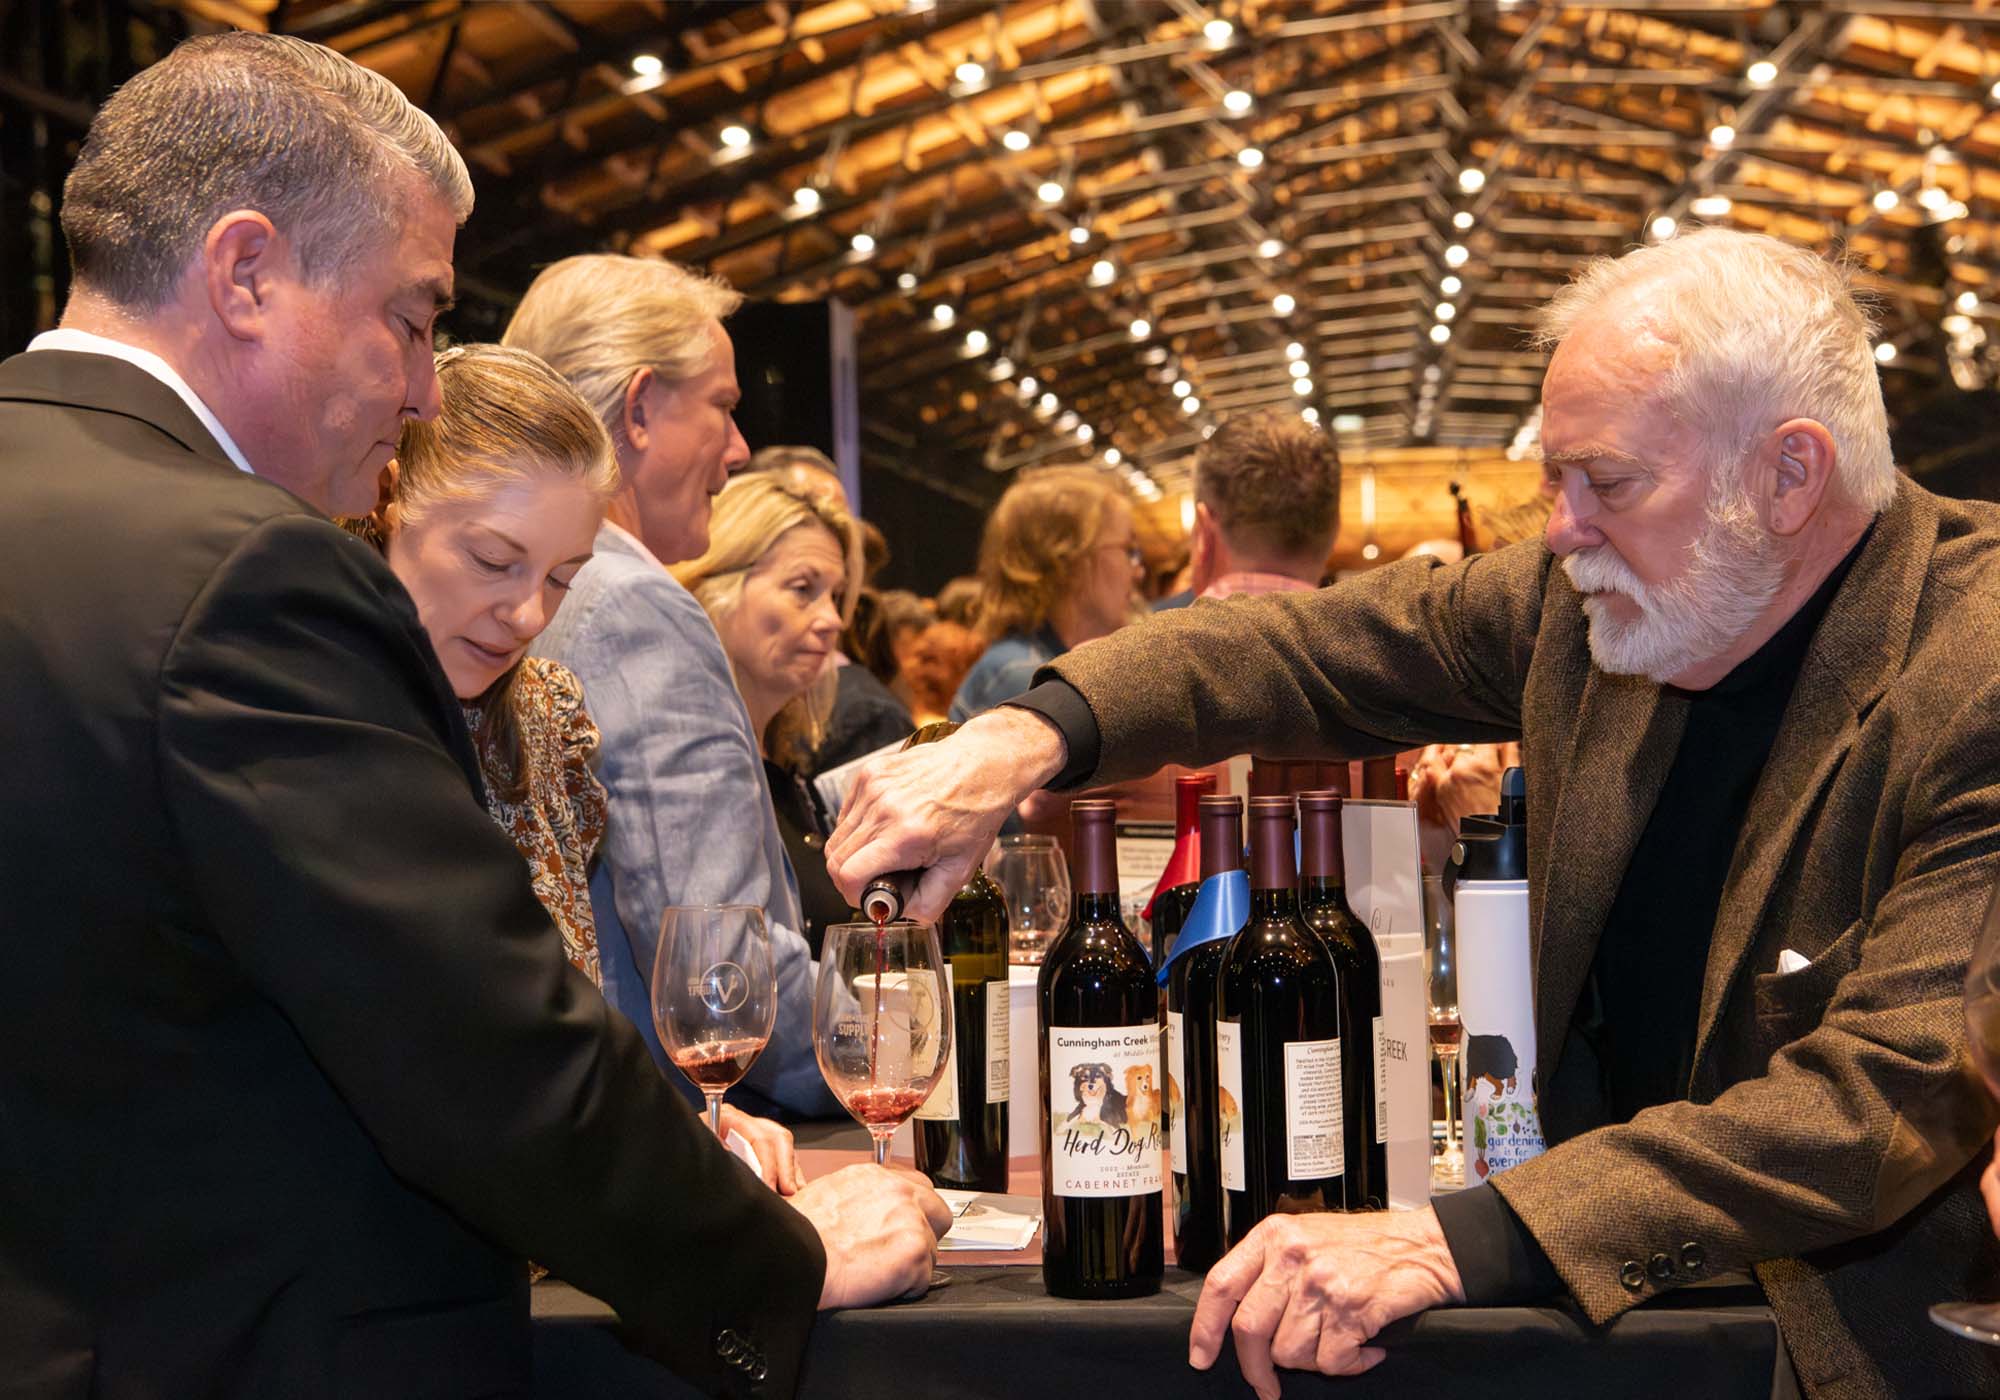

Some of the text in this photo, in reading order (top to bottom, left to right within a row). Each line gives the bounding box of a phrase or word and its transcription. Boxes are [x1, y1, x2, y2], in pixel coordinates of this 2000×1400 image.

[1057, 1037, 1121, 1050] Cunningham
[1123, 1034, 1149, 1047] Creek
[1063, 1128, 1106, 1158] Herd
[1109, 1127, 1145, 1163] Dog
[1065, 1178, 1136, 1190] CABERNET
